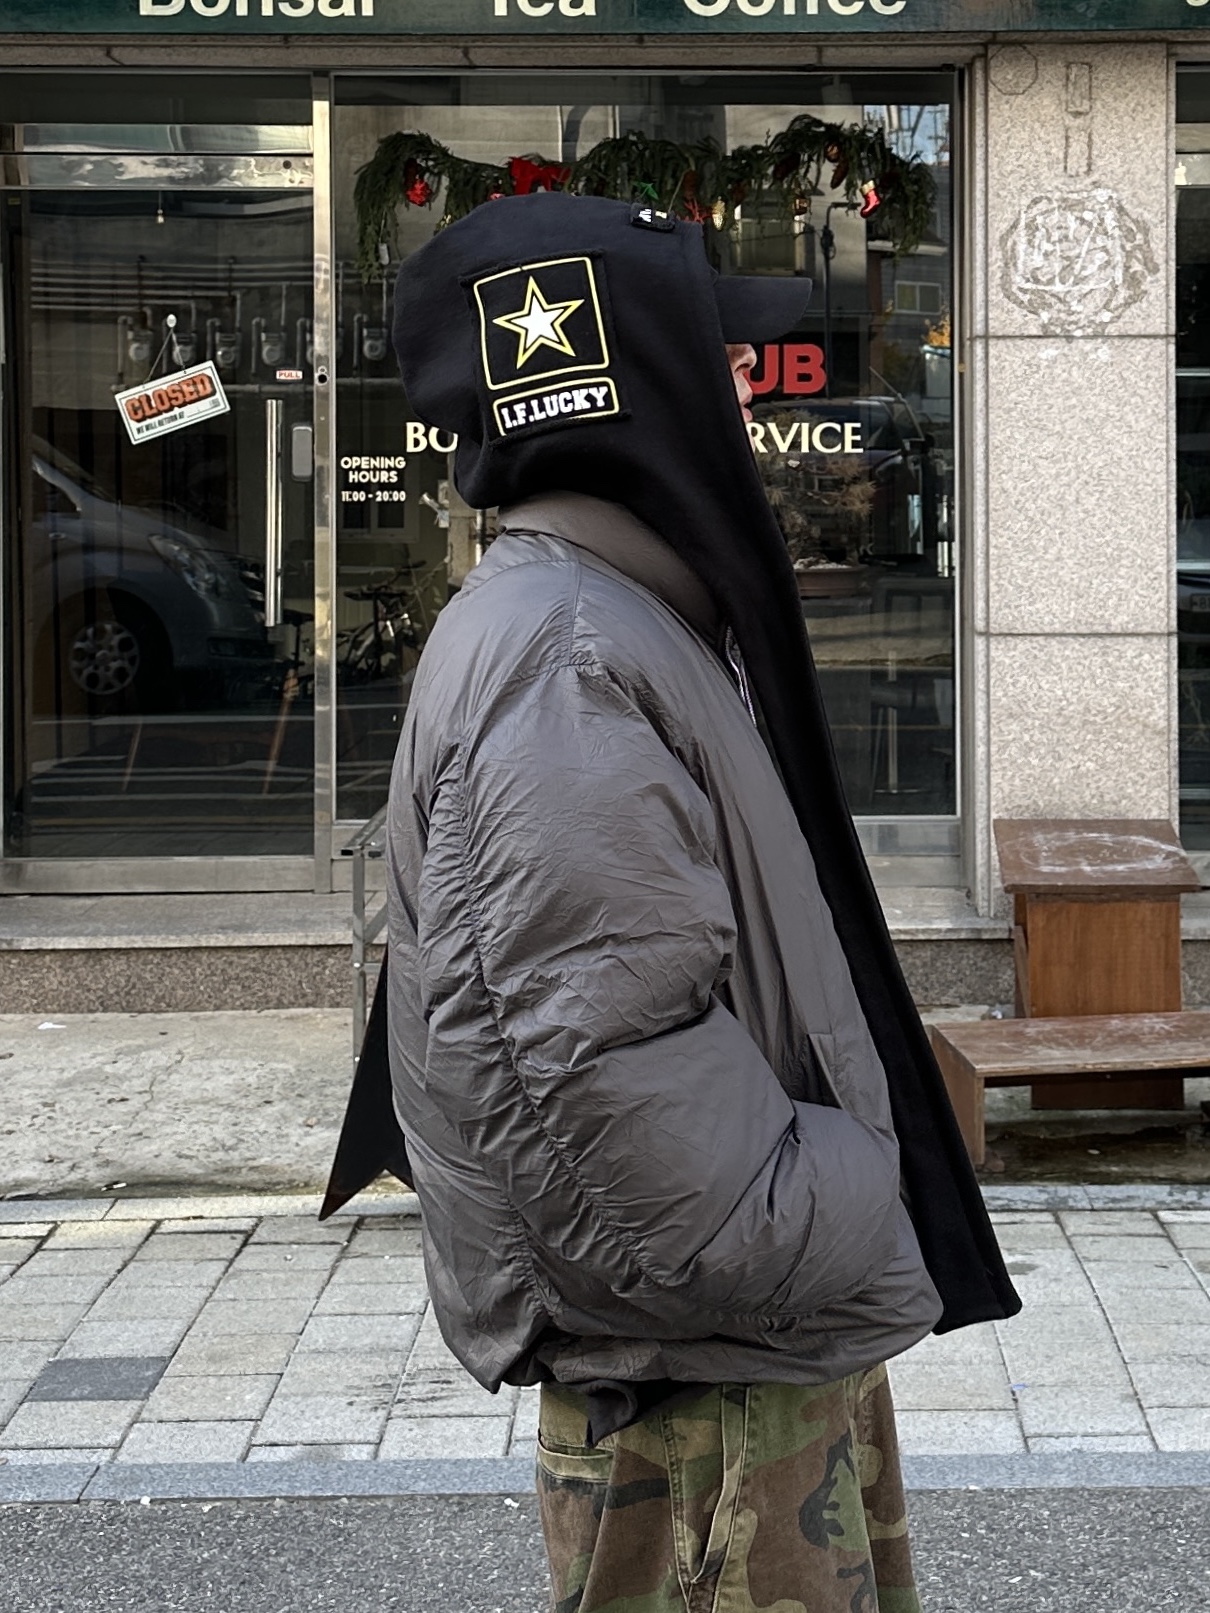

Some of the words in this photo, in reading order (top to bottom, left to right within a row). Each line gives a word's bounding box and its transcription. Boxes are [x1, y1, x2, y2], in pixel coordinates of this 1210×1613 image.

[278, 370, 301, 378] PULL
[124, 373, 217, 423] CLOSED
[501, 386, 608, 429] I.F.LUCKY
[340, 456, 407, 469] OPENING
[348, 470, 399, 483] HOURS
[375, 490, 406, 502] 20:00
